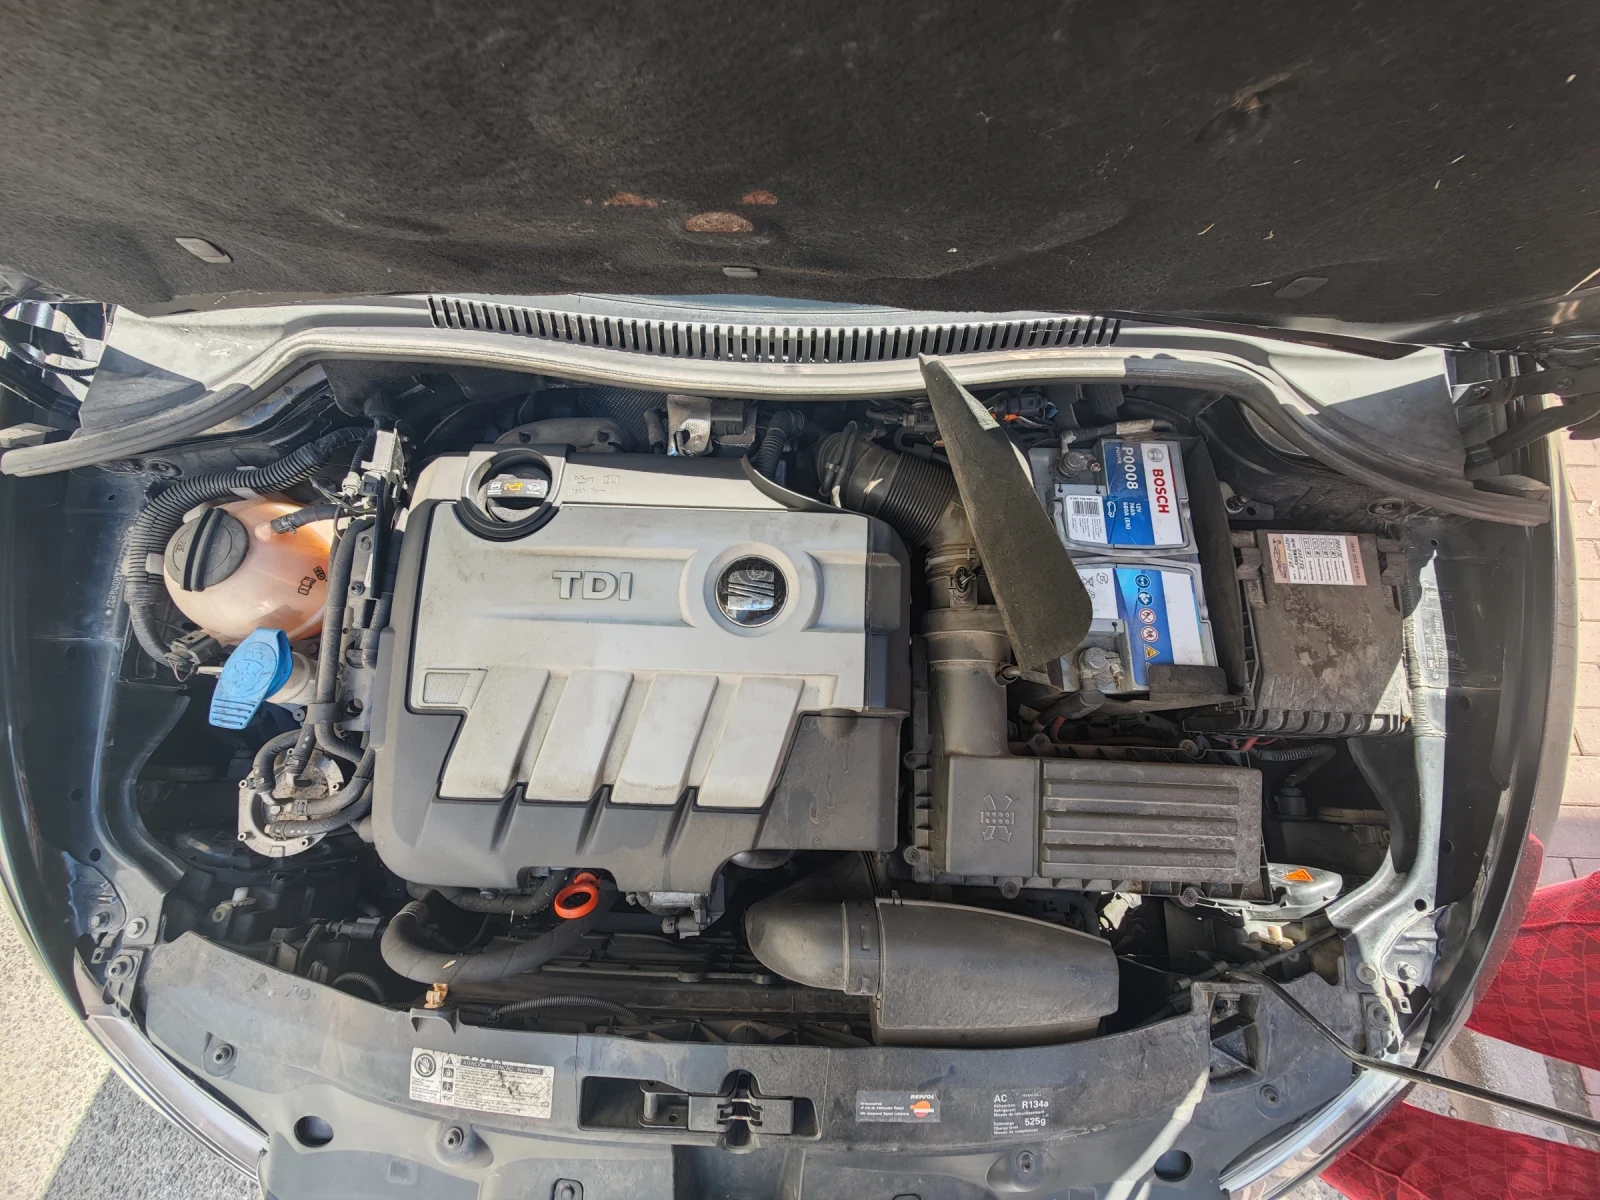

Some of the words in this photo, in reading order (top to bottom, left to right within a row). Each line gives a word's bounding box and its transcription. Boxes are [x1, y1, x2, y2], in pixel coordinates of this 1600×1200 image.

[1122, 447, 1139, 490] P0008
[1152, 468, 1170, 514] BOSCH
[552, 570, 633, 601] TDI
[463, 1060, 487, 1068] ATENCIÓN
[490, 1063, 514, 1072] ATENÇÃO
[517, 1066, 541, 1074] WARNING
[994, 1094, 1008, 1103] AC
[1021, 1100, 1049, 1109] R134a
[1024, 1117, 1046, 1126] 525g
